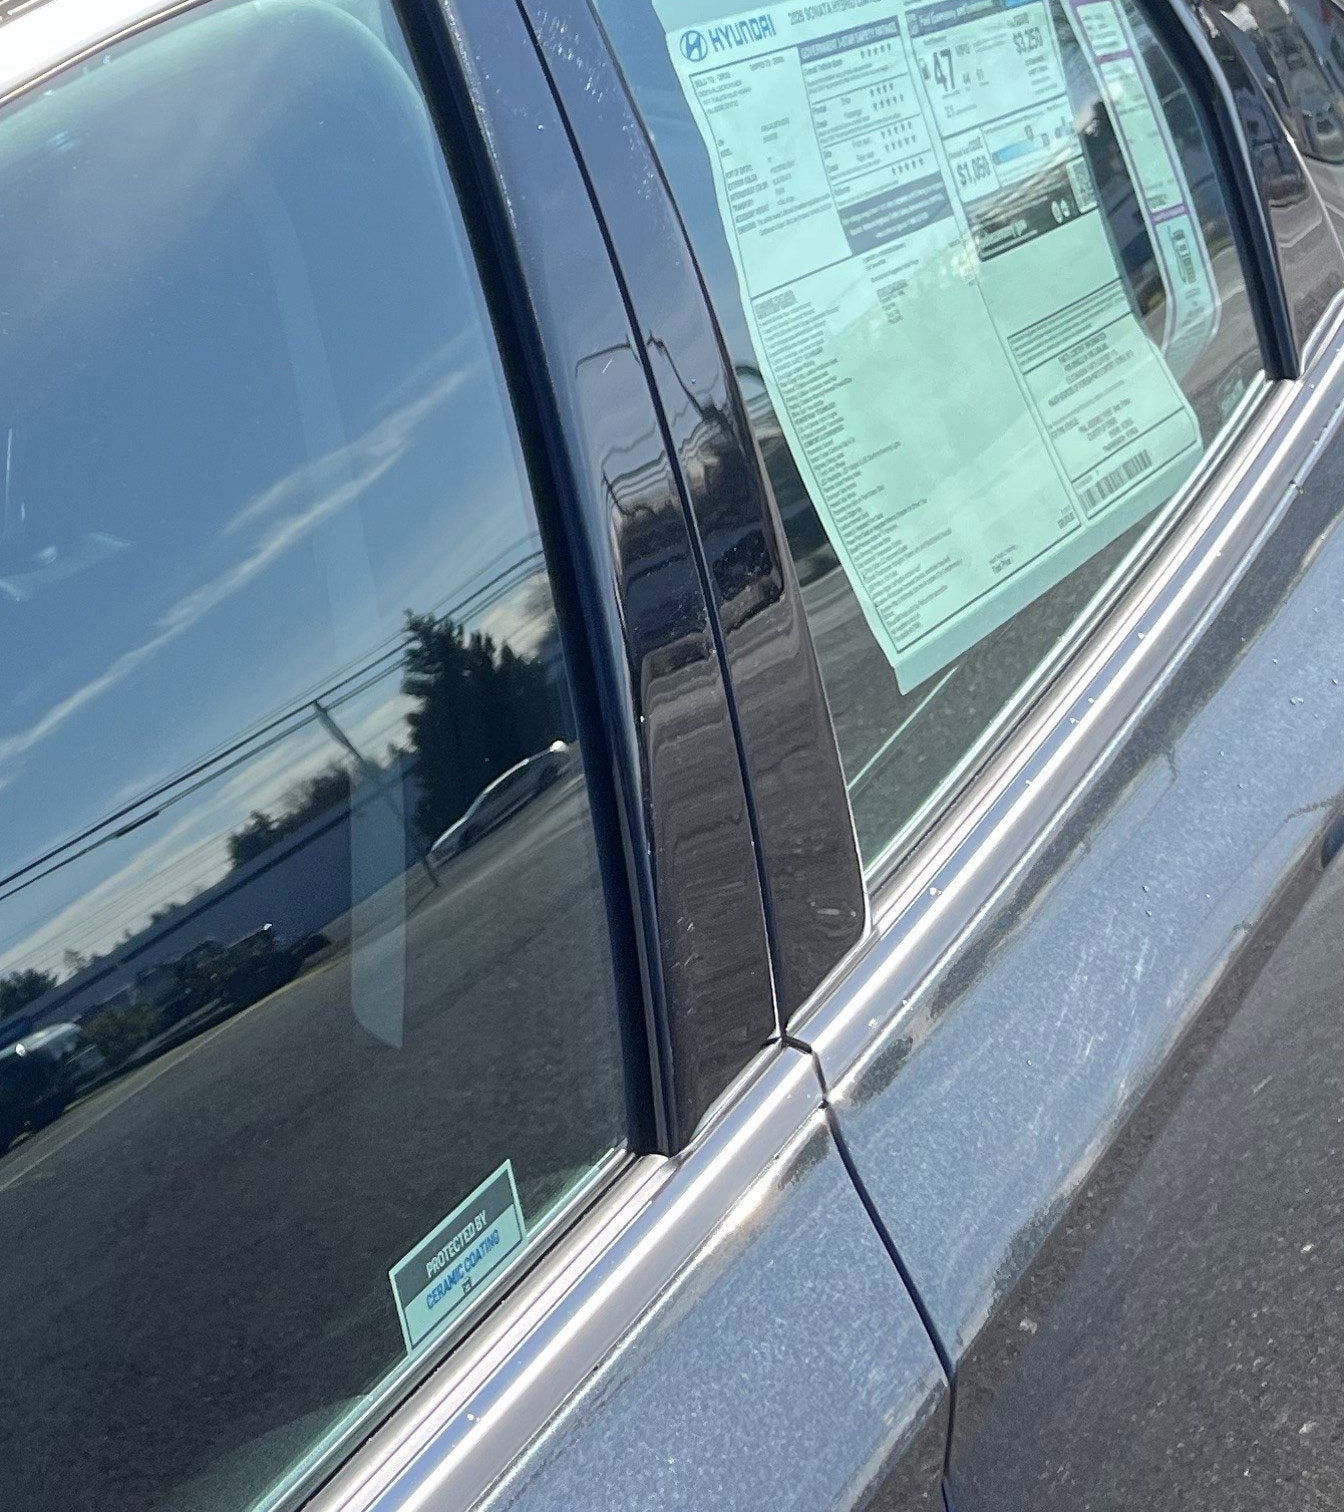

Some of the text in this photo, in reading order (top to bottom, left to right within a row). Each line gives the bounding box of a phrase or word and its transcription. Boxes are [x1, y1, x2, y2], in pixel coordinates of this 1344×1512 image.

[708, 13, 777, 53] HYUNDAI
[933, 47, 956, 92] 47
[425, 1209, 488, 1279] PROTECTED BY
[425, 1228, 501, 1311] CERAMIC COATING
